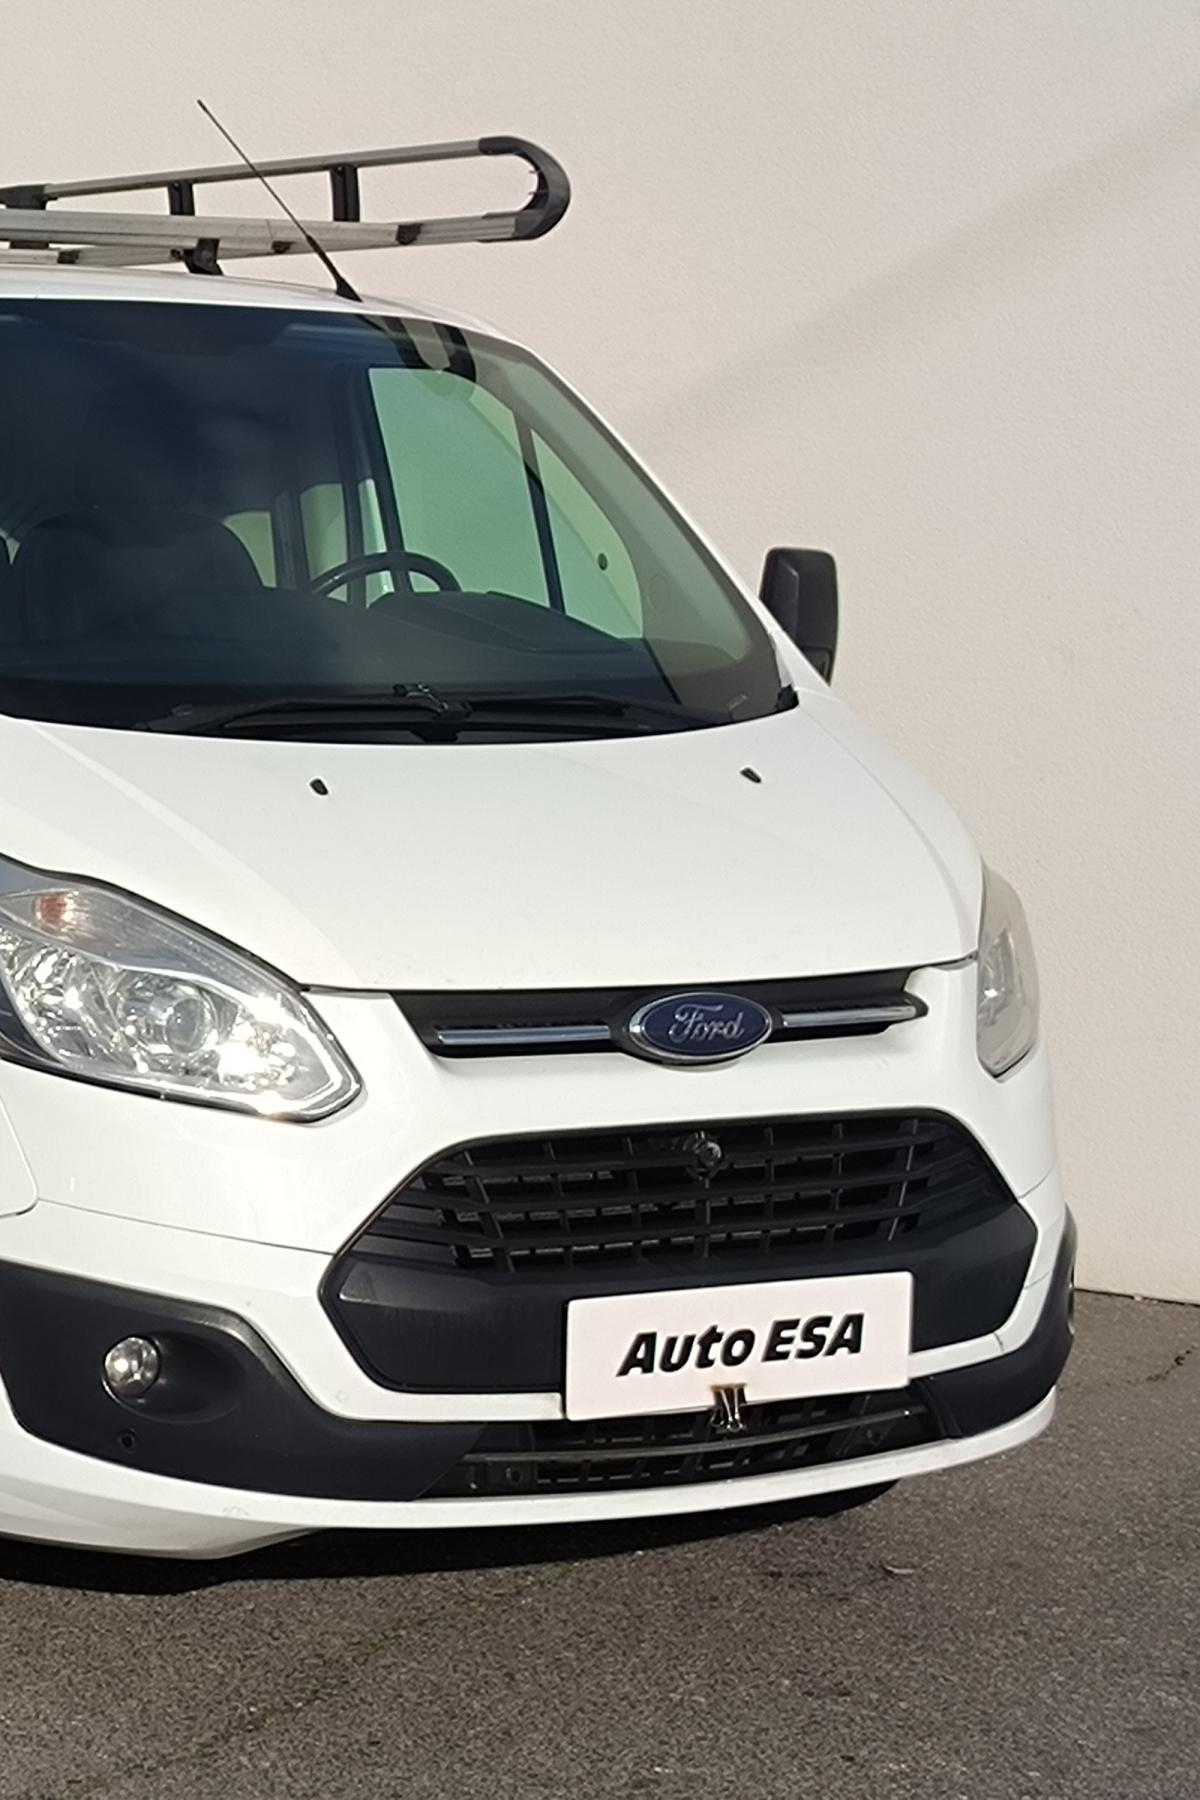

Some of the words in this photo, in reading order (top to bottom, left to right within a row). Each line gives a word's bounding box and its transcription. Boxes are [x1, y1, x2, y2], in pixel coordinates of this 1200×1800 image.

[668, 1003, 745, 1044] Ford
[616, 1324, 756, 1377] Auto
[761, 1313, 865, 1363] ESA
